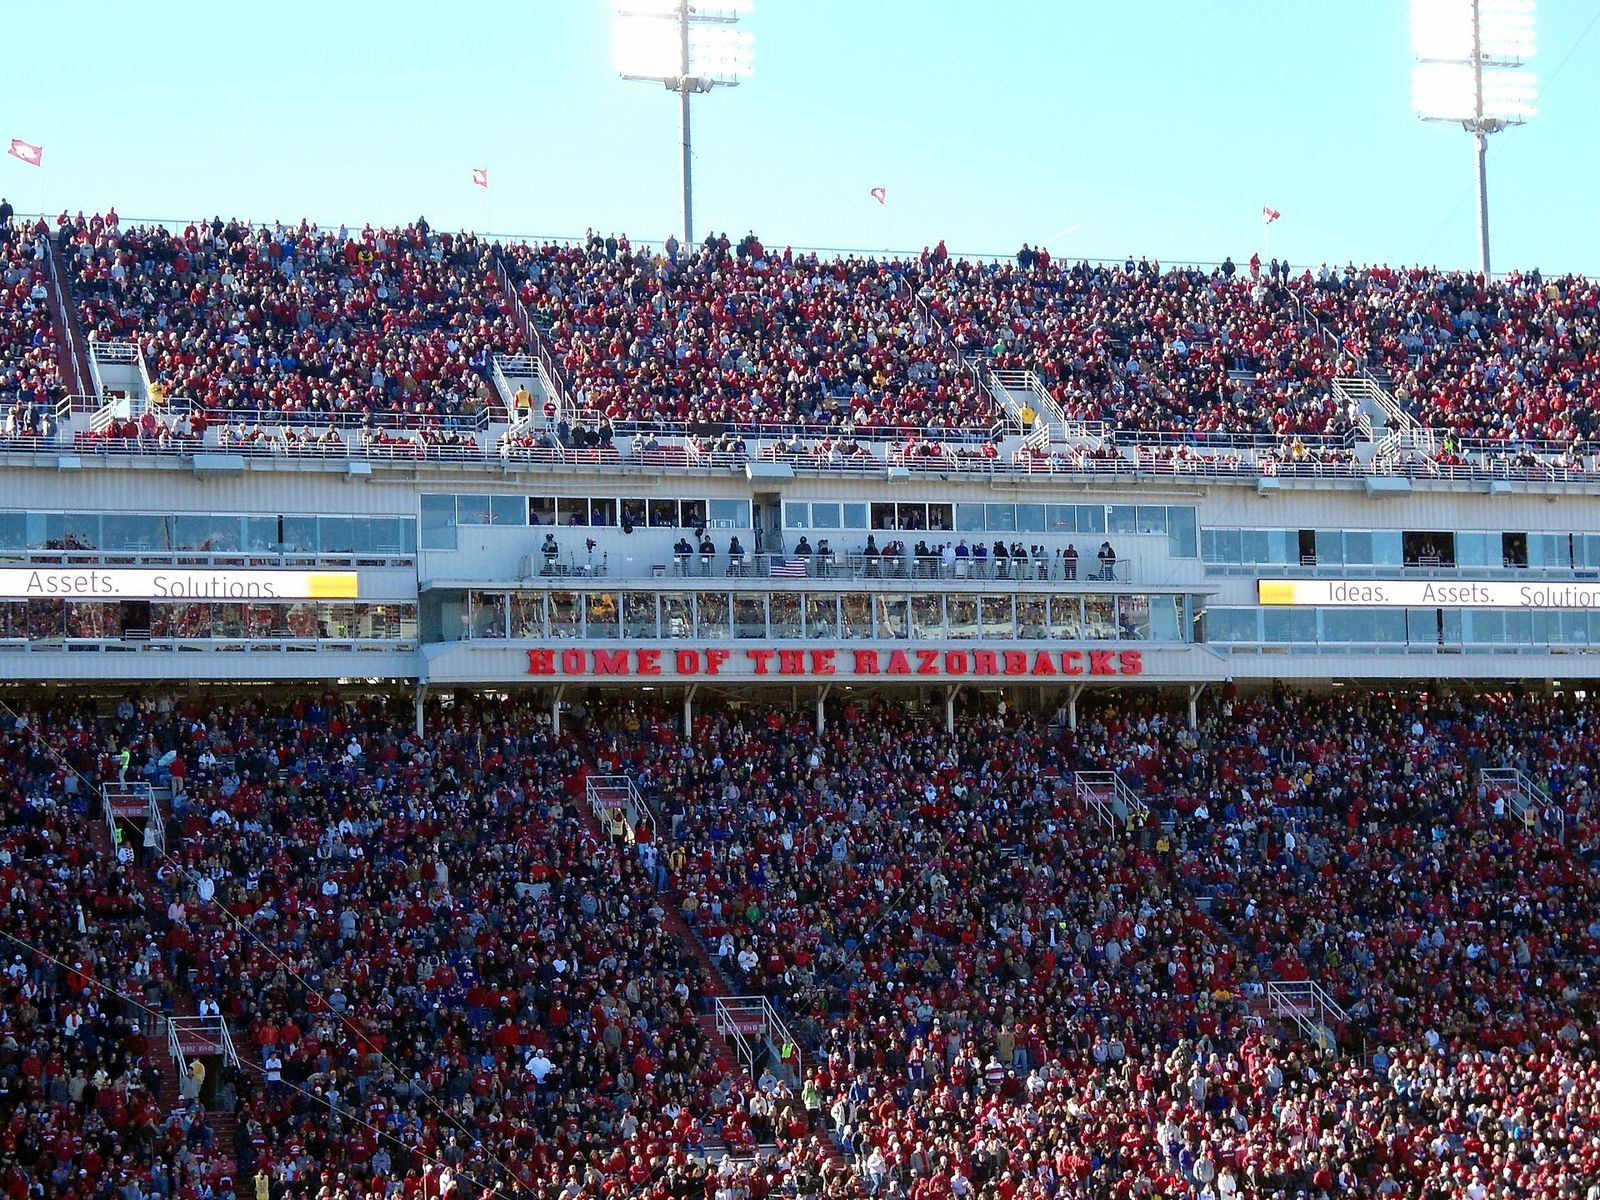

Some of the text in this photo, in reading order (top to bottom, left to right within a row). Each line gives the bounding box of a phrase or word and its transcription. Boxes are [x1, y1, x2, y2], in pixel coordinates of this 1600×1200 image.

[27, 571, 282, 598] Assets. Solutions.
[1329, 582, 1389, 602] Ideas.
[1423, 584, 1495, 603] Assets.
[528, 649, 1142, 676] HOME OF THE RAZORBACKS
